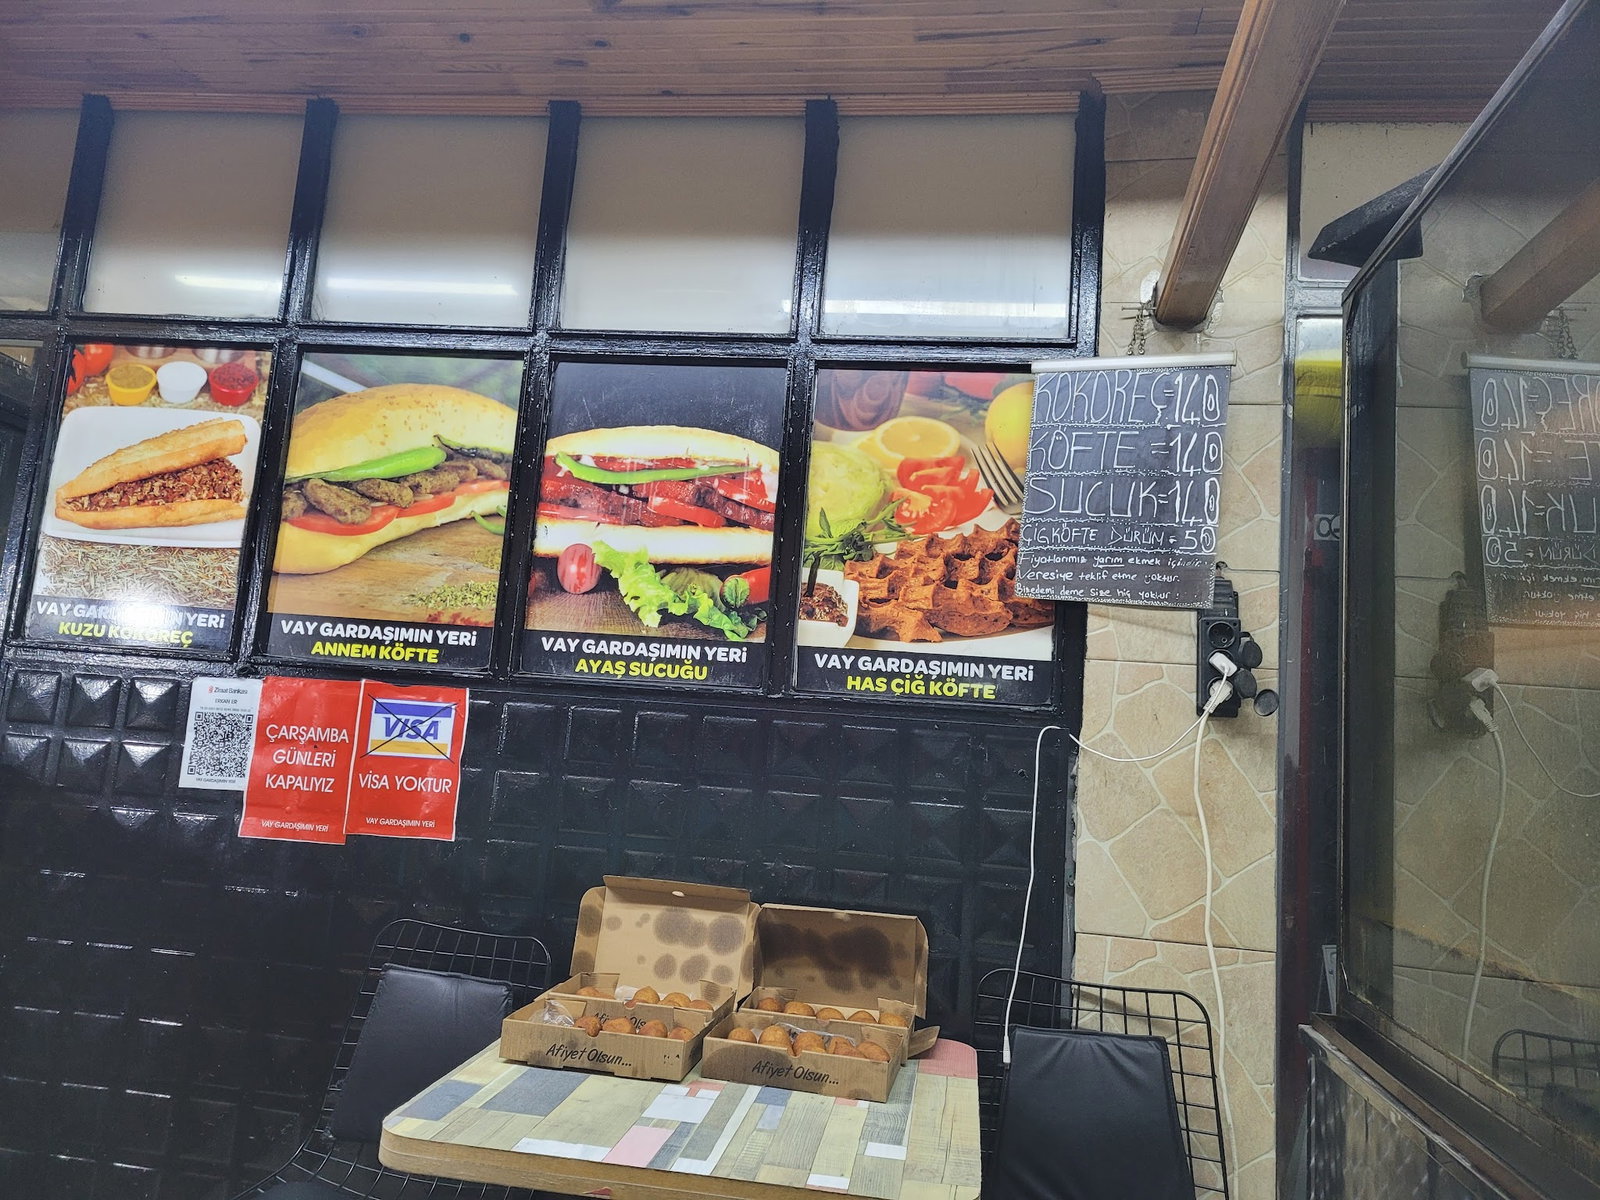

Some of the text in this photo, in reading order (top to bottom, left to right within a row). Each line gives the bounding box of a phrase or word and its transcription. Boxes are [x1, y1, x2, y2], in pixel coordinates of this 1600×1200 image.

[1029, 426, 1139, 471] KÖFTE
[1108, 526, 1164, 545] DÜRÜN
[1179, 527, 1216, 552] 50
[1093, 556, 1123, 568] yarım
[1128, 557, 1160, 566] ekmek
[1018, 569, 1073, 581] Veresiye
[1112, 572, 1137, 581] etme
[1060, 585, 1084, 596] deme
[36, 601, 73, 616] VAY
[58, 621, 105, 638] KUZU
[280, 619, 317, 636] VAY
[320, 622, 433, 645] GARDAŞIMIN
[311, 641, 440, 663] ANNEM KÖFTE
[541, 636, 579, 653] VAY
[582, 639, 700, 663] GARDAŞIMIN
[575, 658, 708, 680] AYAŞ SUCUĞU
[814, 653, 855, 669] VAY
[857, 655, 984, 681] GARDAŞIMIN
[847, 673, 997, 700] HAS ÇİĞ KÖFTE
[265, 724, 349, 745] ÇARŞAMBA
[383, 716, 439, 740] VISA
[272, 747, 336, 767] GÜNLERİ
[265, 774, 335, 793] KAPALIYIZ
[359, 770, 452, 794] VİSA YOKTUR
[261, 820, 273, 828] VAY
[274, 821, 314, 831] GARDAŞIMIN
[379, 818, 420, 828] GARDAŞIMIN
[546, 1043, 632, 1067] Afiyet Olsun...
[751, 1060, 839, 1085] Afiyet Olsun...
